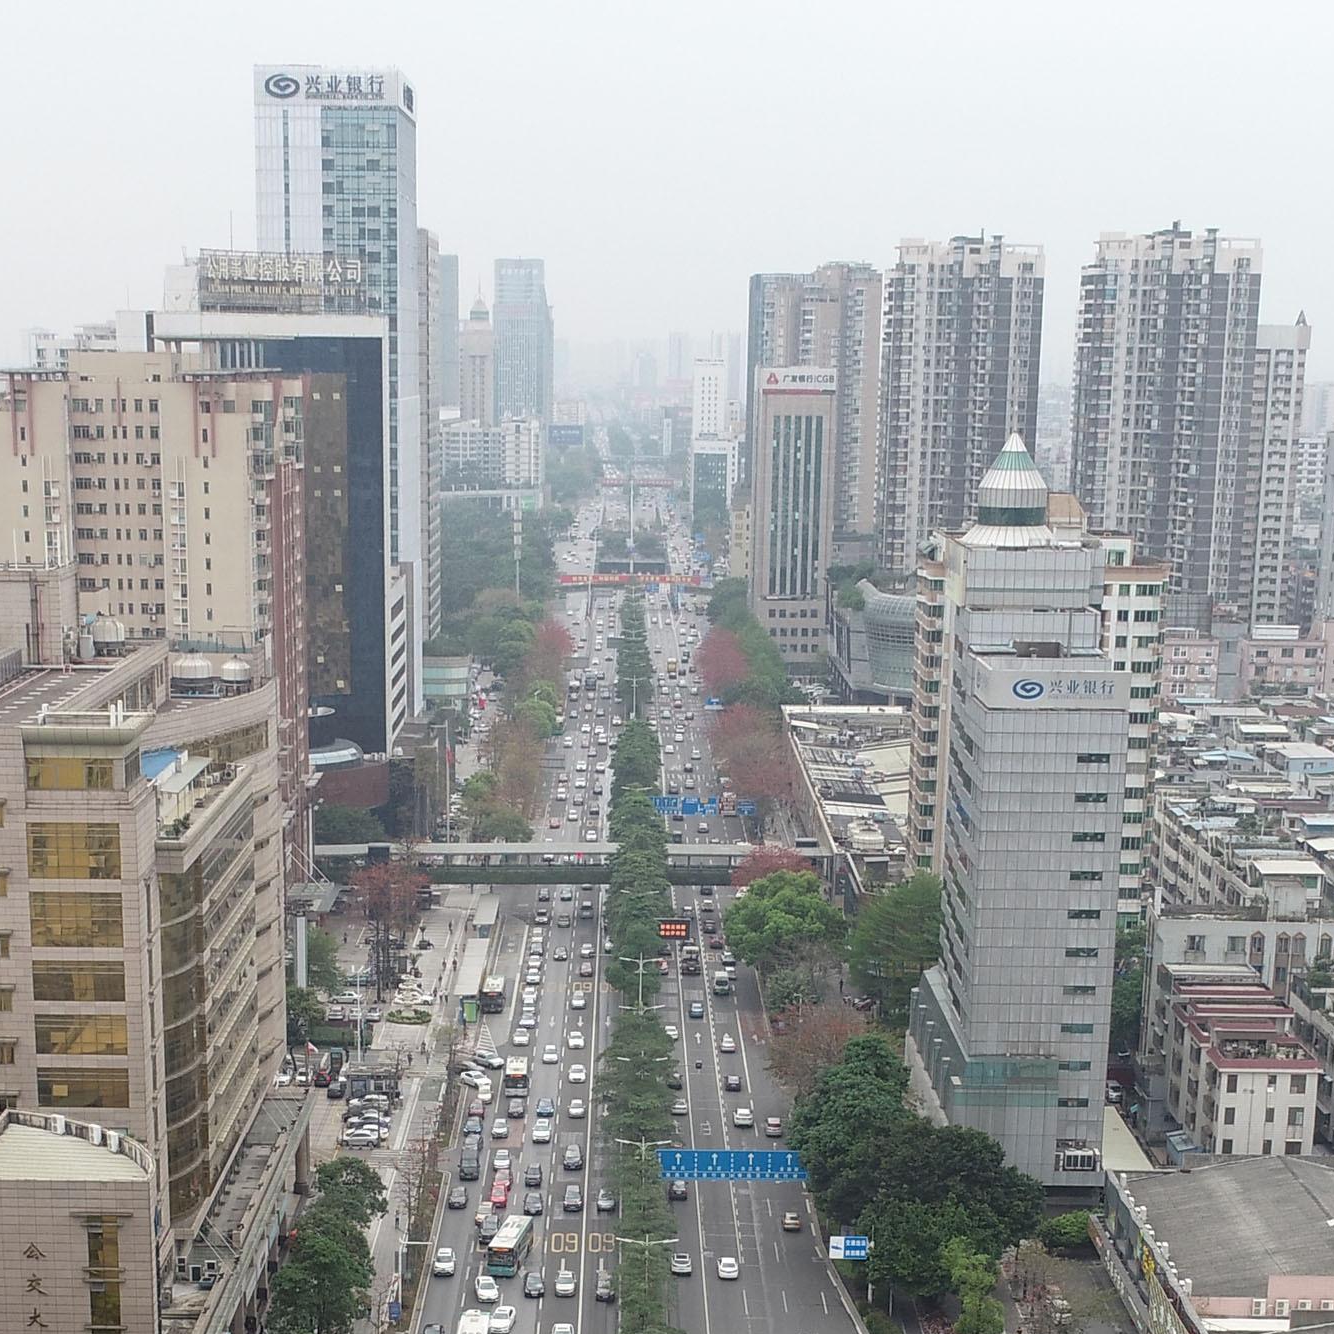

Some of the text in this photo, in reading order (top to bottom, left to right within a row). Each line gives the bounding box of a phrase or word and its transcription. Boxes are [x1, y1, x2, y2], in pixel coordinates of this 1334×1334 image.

[305, 75, 384, 93] 兴业银行
[207, 254, 361, 283] 公用事业控股有限公司
[816, 374, 835, 383] CGB
[1050, 680, 1115, 695] 兴业银行
